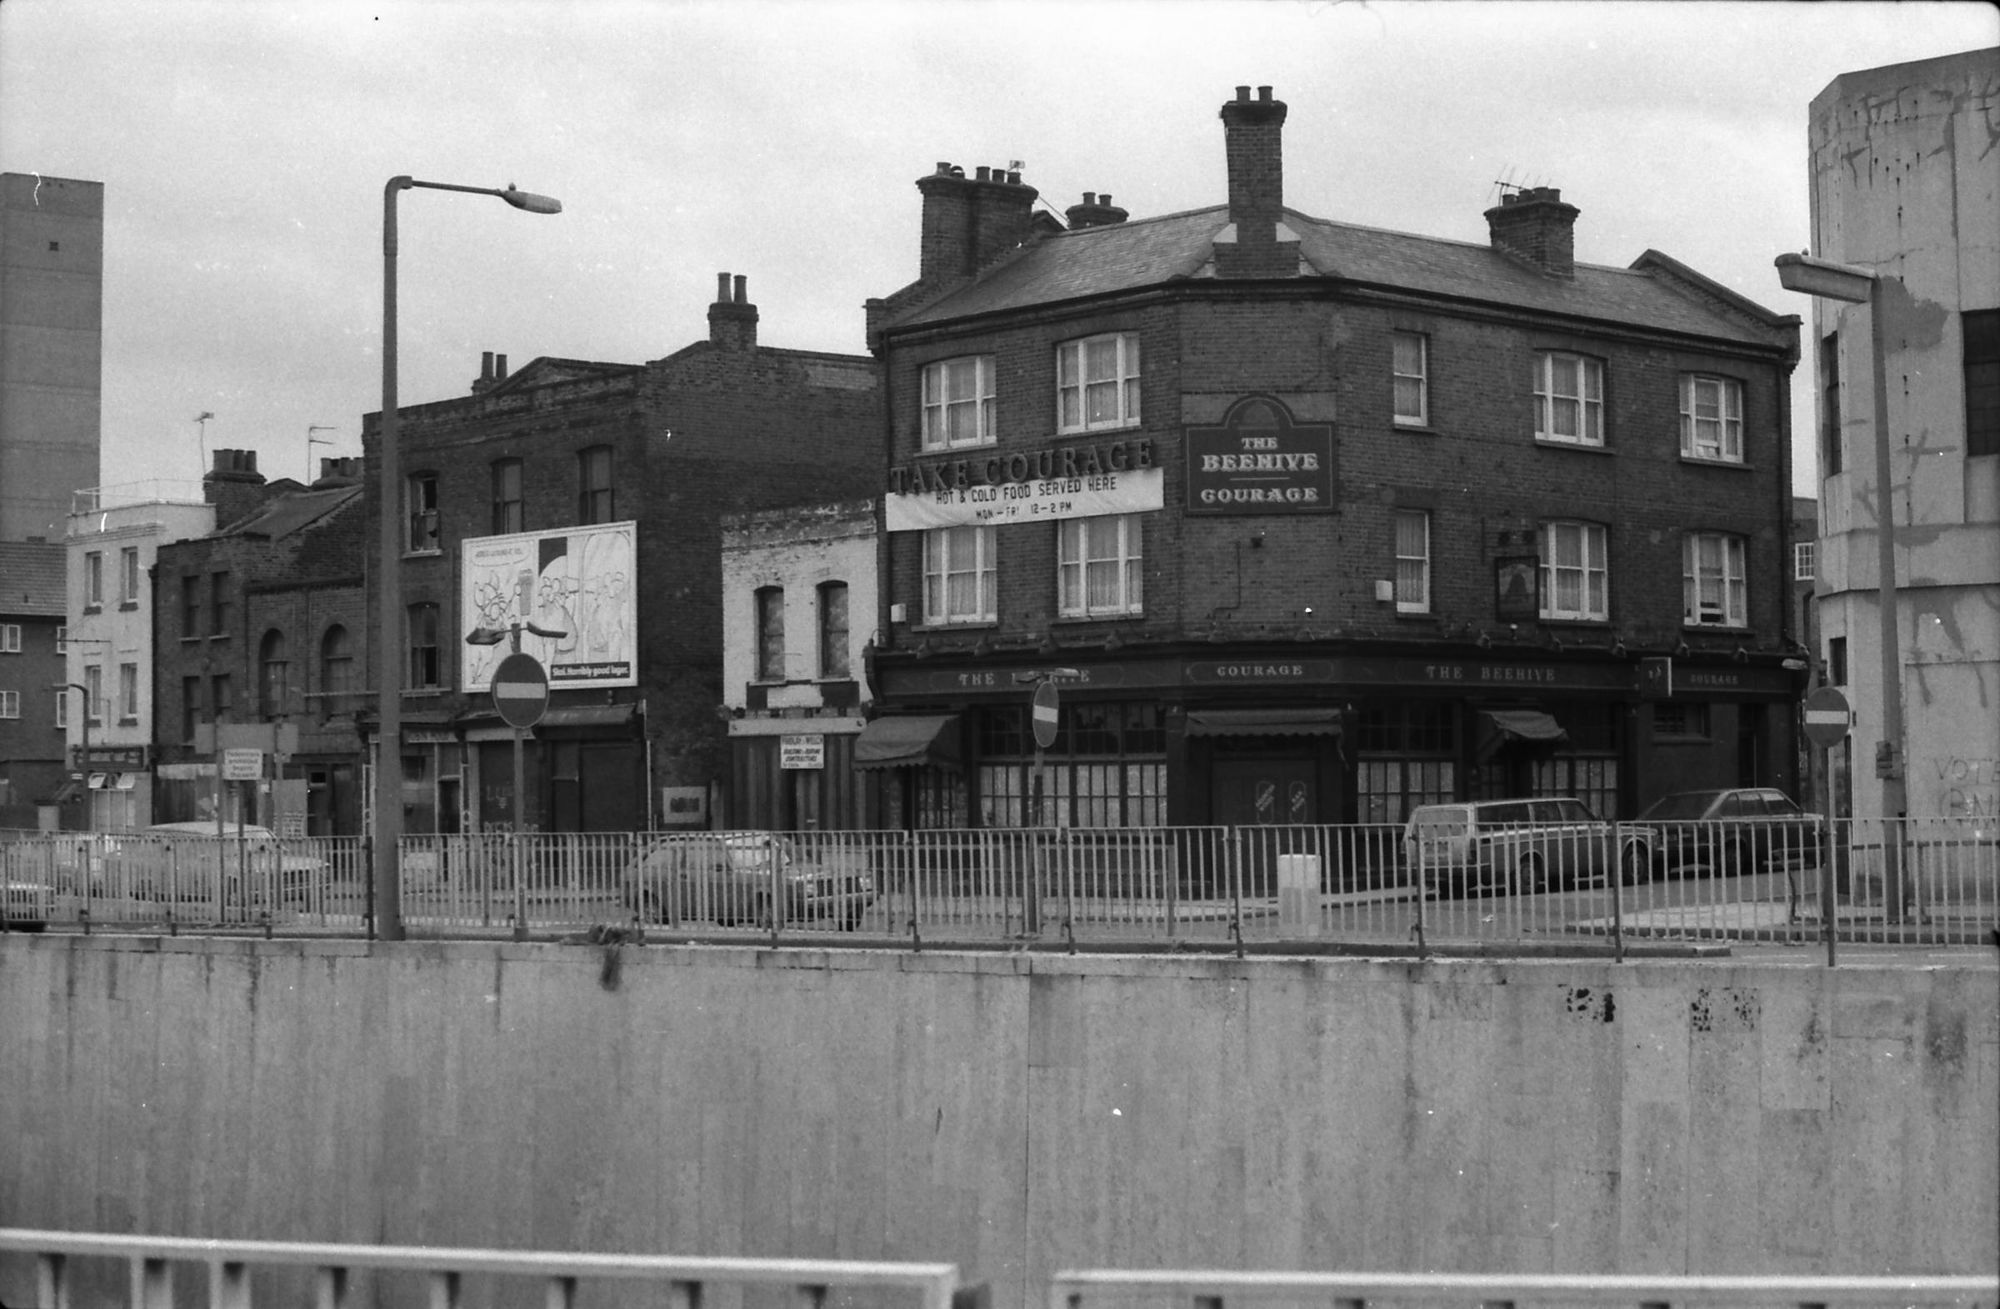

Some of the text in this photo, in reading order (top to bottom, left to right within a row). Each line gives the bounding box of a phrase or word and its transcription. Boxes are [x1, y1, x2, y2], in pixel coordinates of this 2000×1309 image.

[1241, 437, 1278, 450] THE
[892, 439, 1154, 496] TAKE COURAGE
[1201, 453, 1319, 472] BEEHIVE
[936, 490, 954, 505] HOT
[971, 488, 997, 503] COLD
[1003, 486, 1031, 500] FOOD
[1038, 479, 1081, 497] SERVED
[1088, 477, 1117, 492] HERE
[1200, 487, 1319, 503] COURAGE
[976, 509, 993, 519] MON
[1216, 665, 1303, 677] COURAGE
[1425, 665, 1555, 681] THE BEEHIVE
[958, 673, 995, 686] THE
[1934, 755, 2000, 785] VOTE
